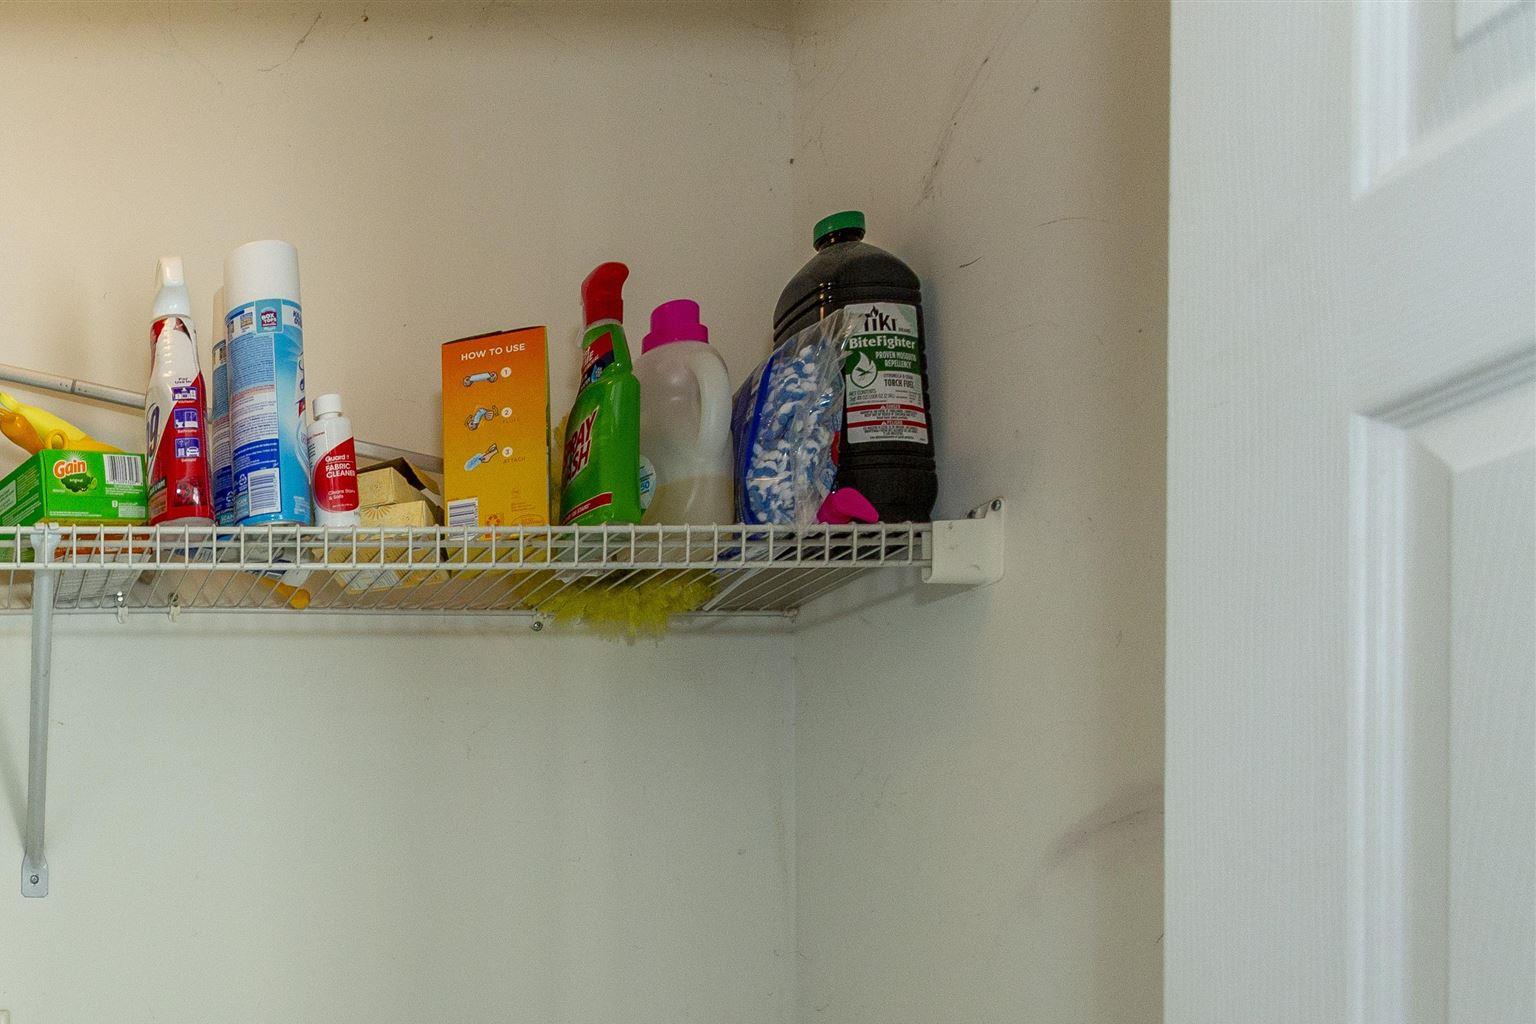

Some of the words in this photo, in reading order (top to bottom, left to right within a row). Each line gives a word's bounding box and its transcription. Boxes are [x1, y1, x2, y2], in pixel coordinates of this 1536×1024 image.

[849, 335, 916, 350] BiteFighter
[460, 349, 487, 361] HOW
[488, 346, 503, 357] TO
[505, 342, 526, 353] USE
[875, 350, 896, 359] PROVEN
[884, 379, 903, 387] TORCH
[904, 380, 914, 389] FUEL
[53, 459, 88, 479] Gain
[325, 463, 351, 473] FABRIC
